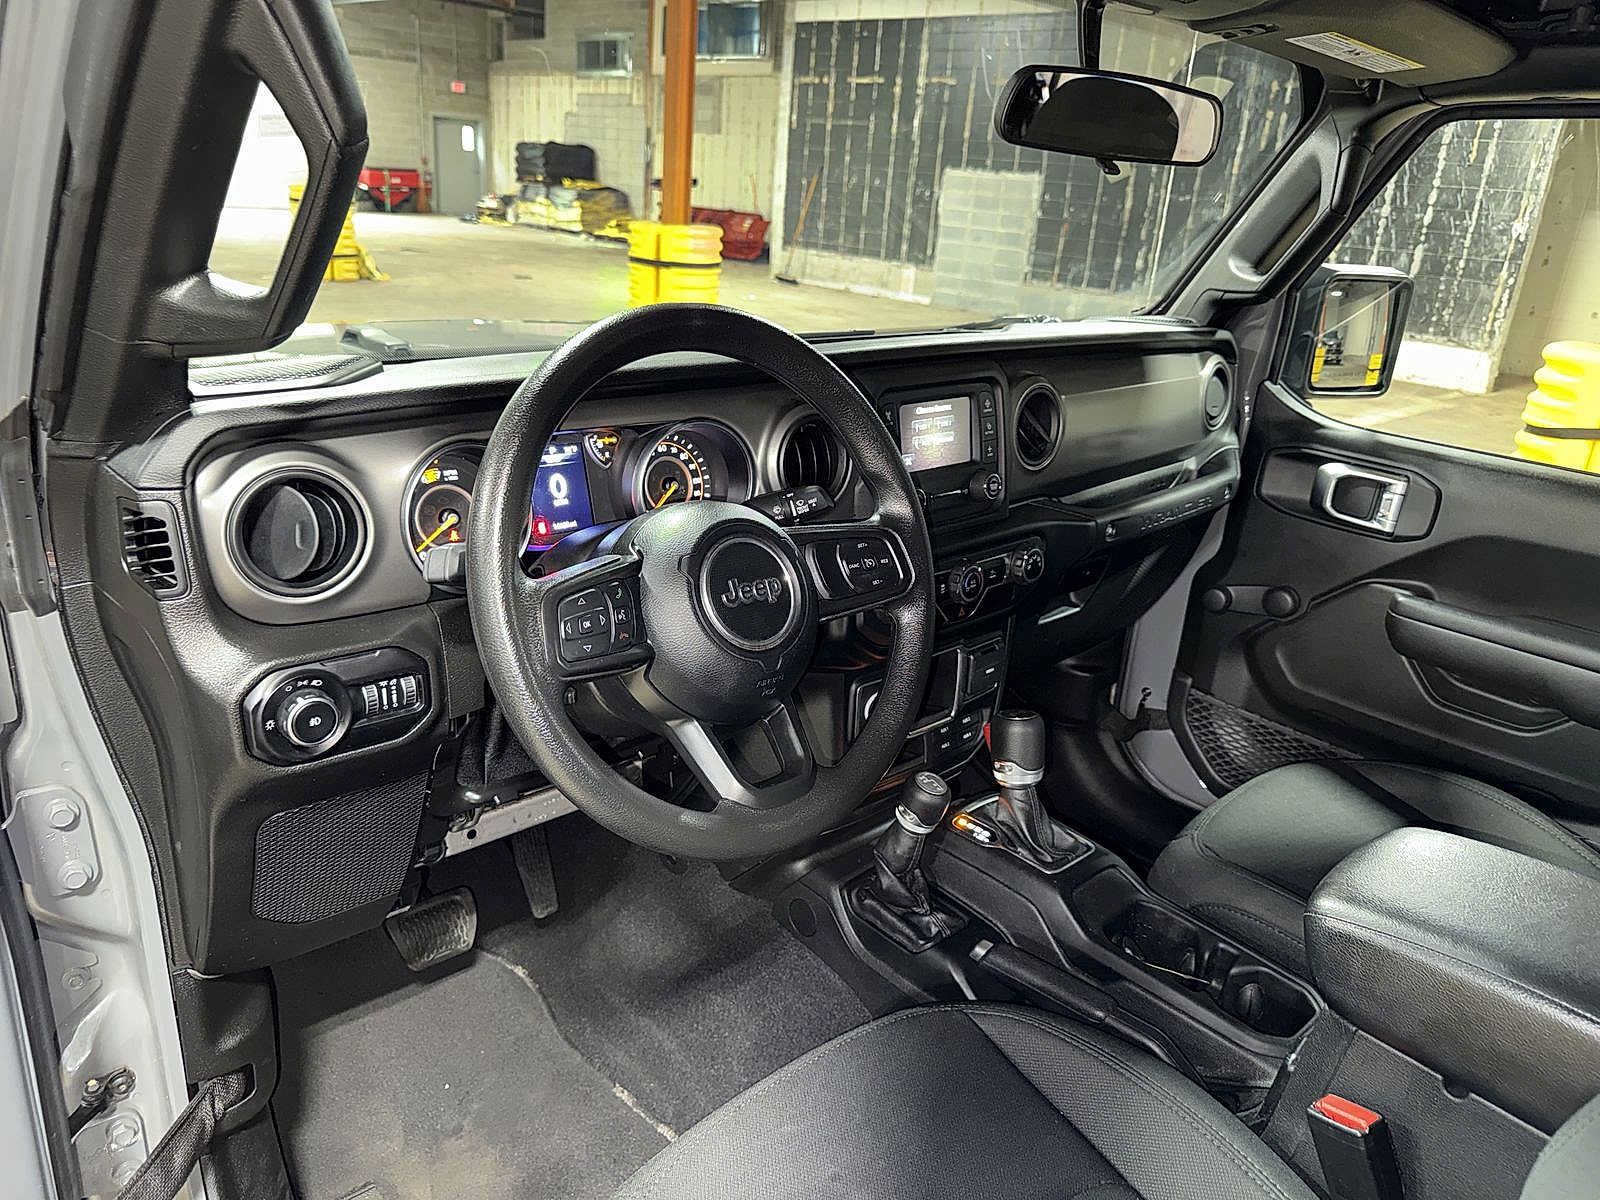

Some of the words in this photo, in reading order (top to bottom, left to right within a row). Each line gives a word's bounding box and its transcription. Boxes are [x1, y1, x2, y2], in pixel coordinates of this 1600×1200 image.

[549, 473, 568, 499] 0
[721, 577, 782, 608] Jeep
[582, 619, 593, 630] OK
